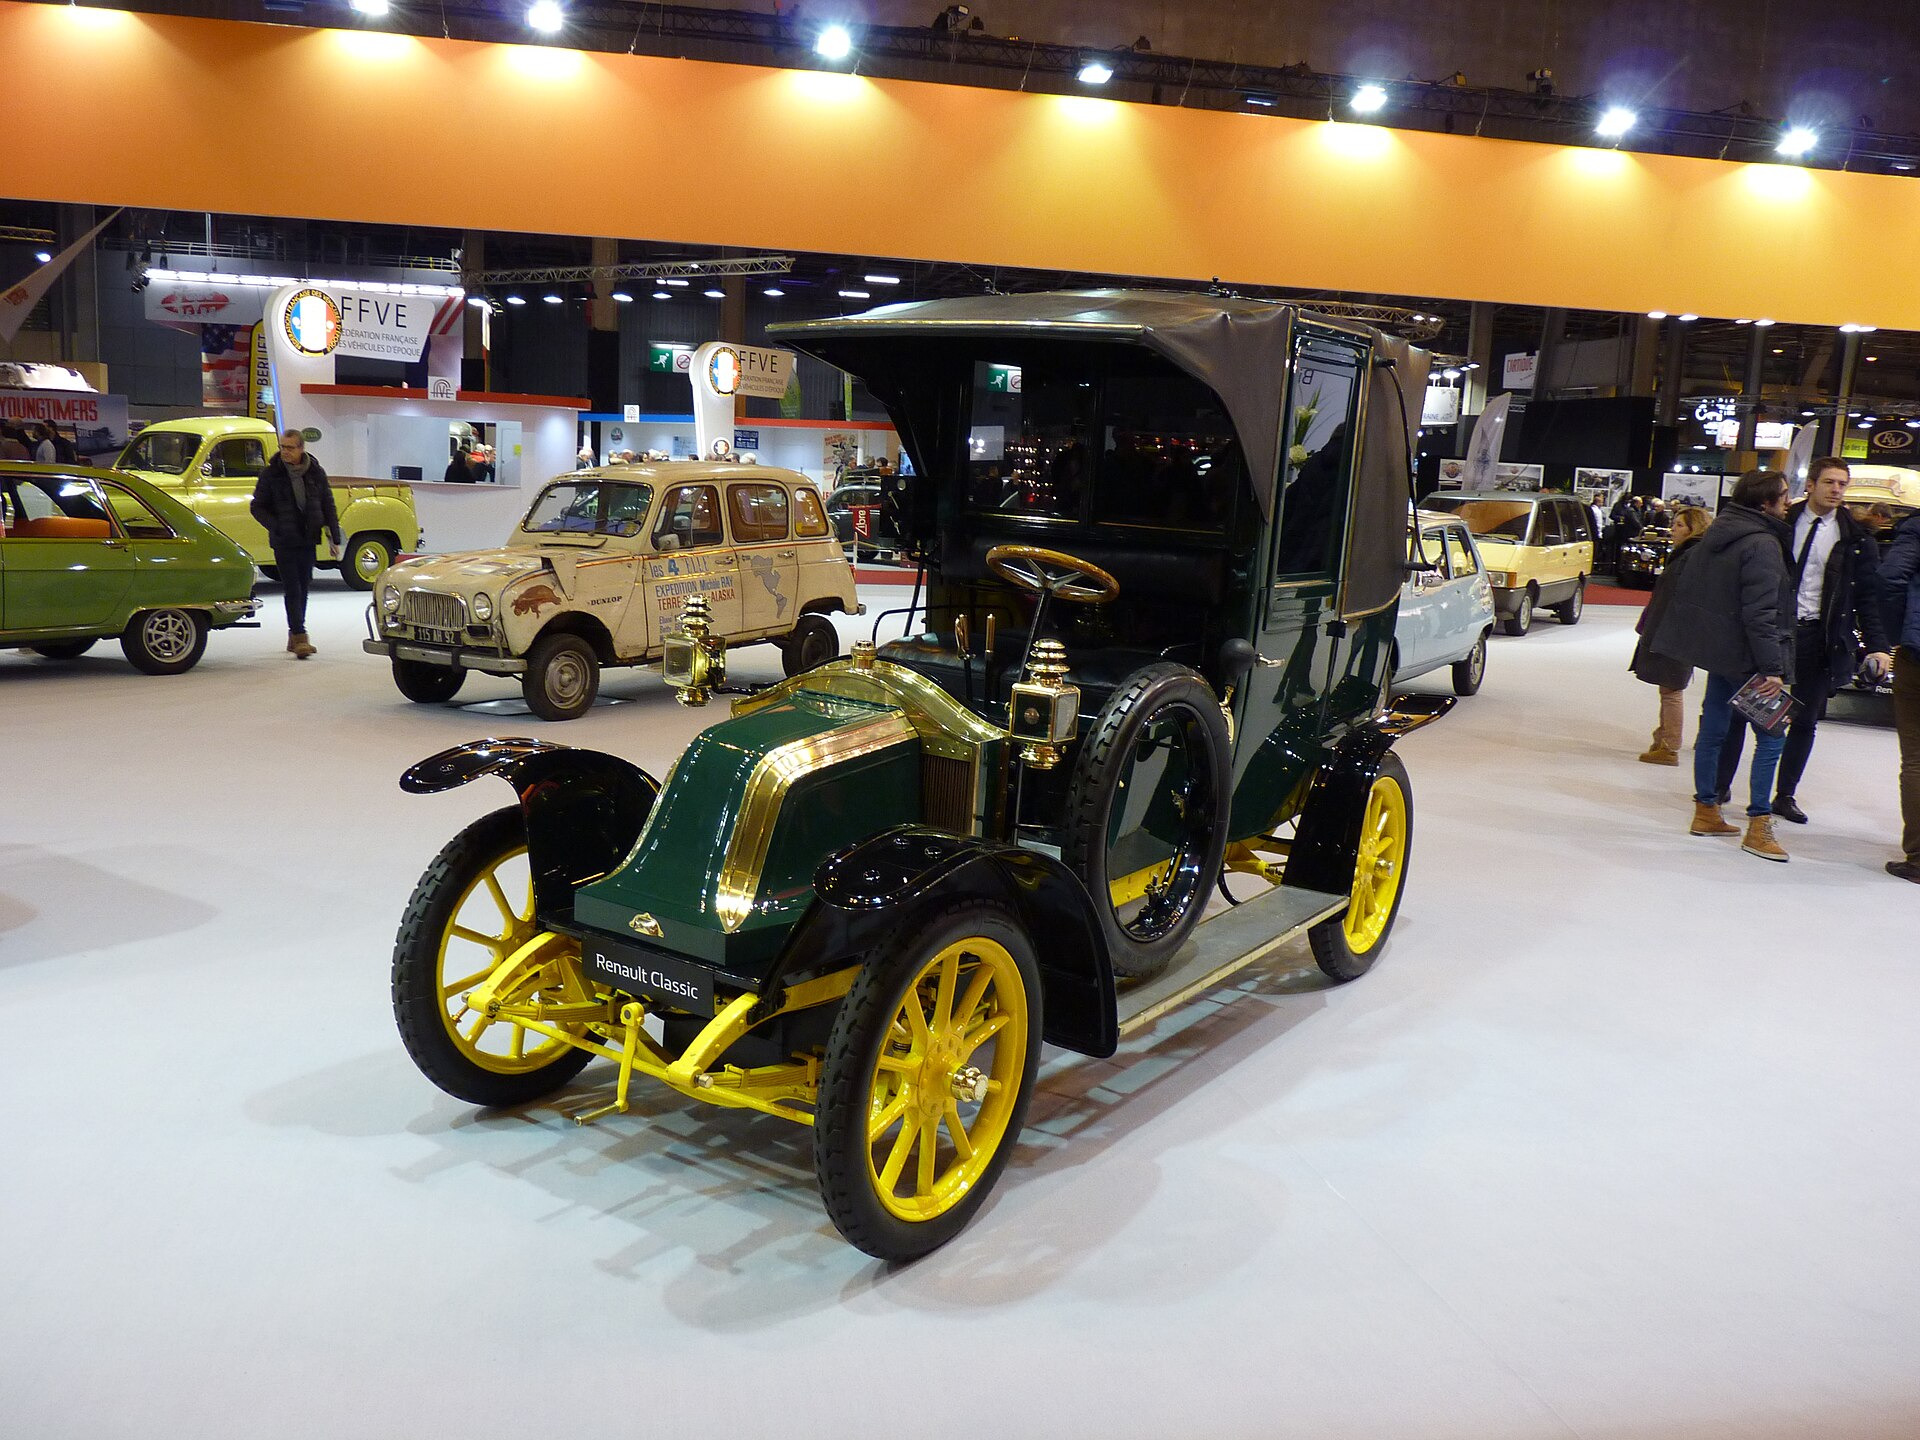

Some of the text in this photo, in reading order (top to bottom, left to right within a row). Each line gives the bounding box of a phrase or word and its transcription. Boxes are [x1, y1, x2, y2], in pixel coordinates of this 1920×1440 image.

[341, 296, 407, 328] FFVE
[338, 339, 346, 348] ES
[347, 340, 385, 353] VÉHICULES
[381, 333, 418, 345] FRANÇAISE
[739, 350, 778, 373] FFVE
[0, 396, 98, 421] YOUNGTIMERS
[649, 562, 664, 577] les
[668, 559, 679, 575] 4
[655, 581, 697, 597] EXPEDITION
[721, 575, 734, 588] RAY
[591, 595, 622, 606] DUNLOP
[658, 596, 680, 611] TERRE
[1875, 685, 1894, 695] Ren
[596, 953, 699, 1000] Renault Classic
